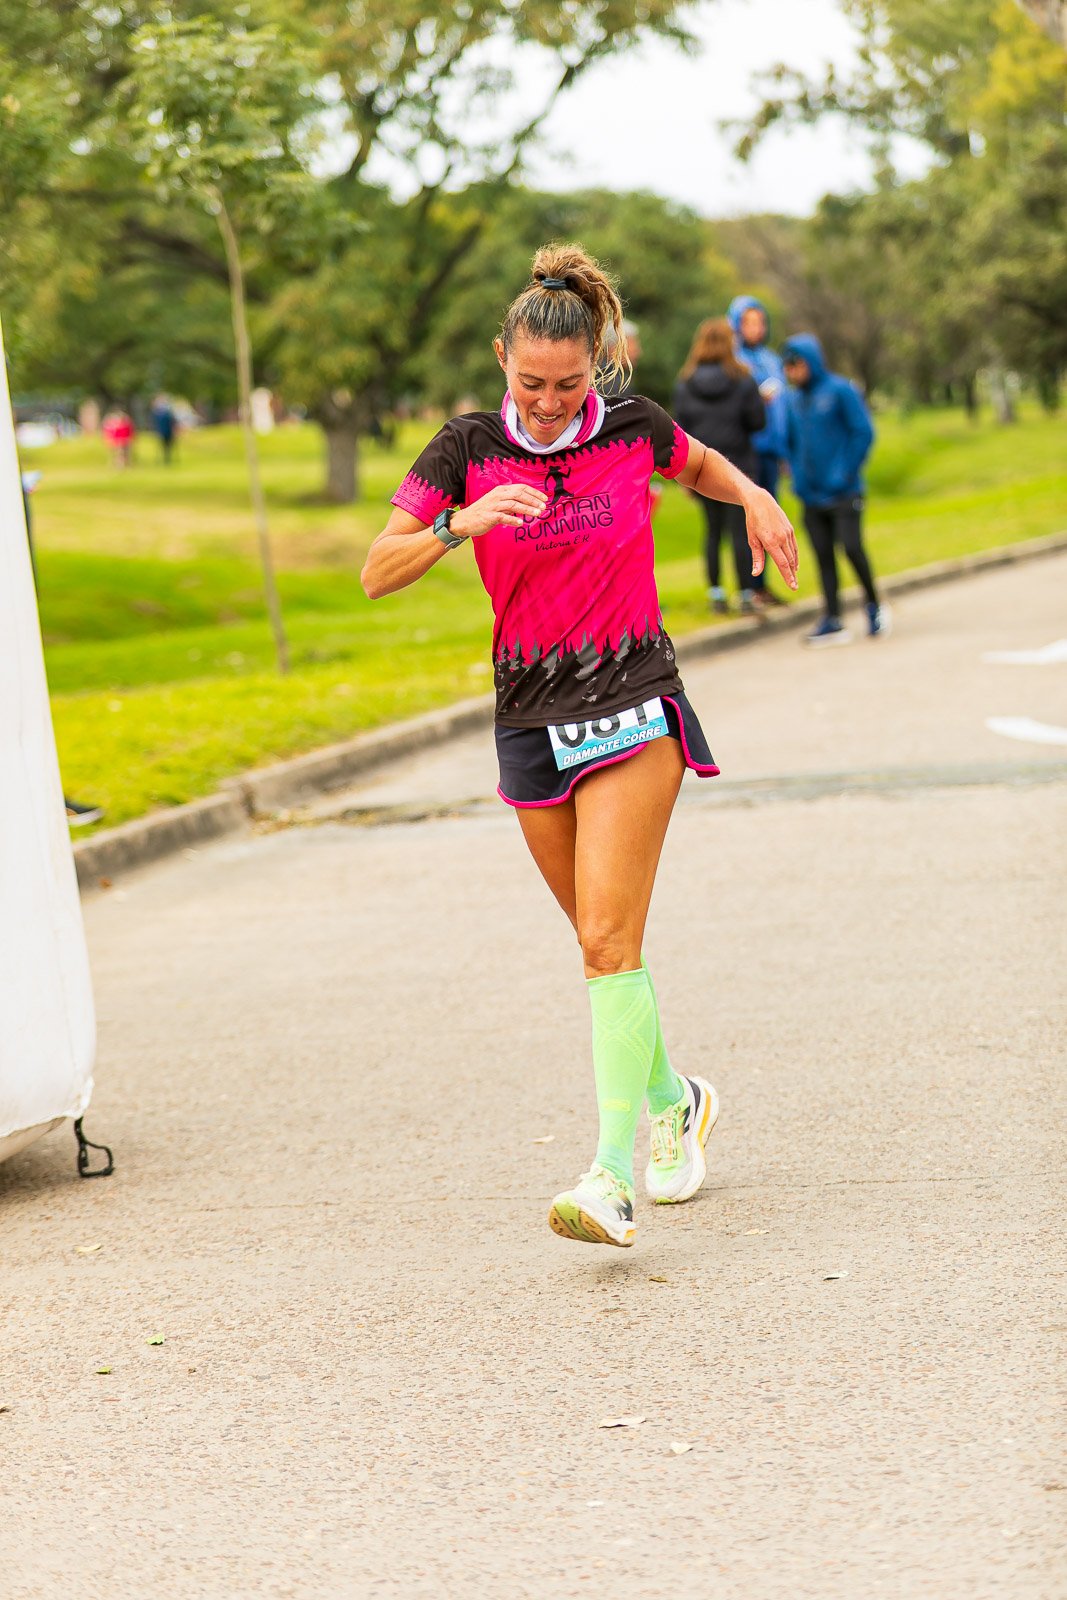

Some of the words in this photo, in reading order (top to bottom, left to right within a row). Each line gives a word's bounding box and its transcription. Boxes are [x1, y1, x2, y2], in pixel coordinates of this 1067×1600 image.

[515, 511, 614, 543] RUNNING
[535, 540, 571, 552] Victoria
[563, 738, 620, 766] DIAMANTE
[623, 726, 661, 745] CORRE
